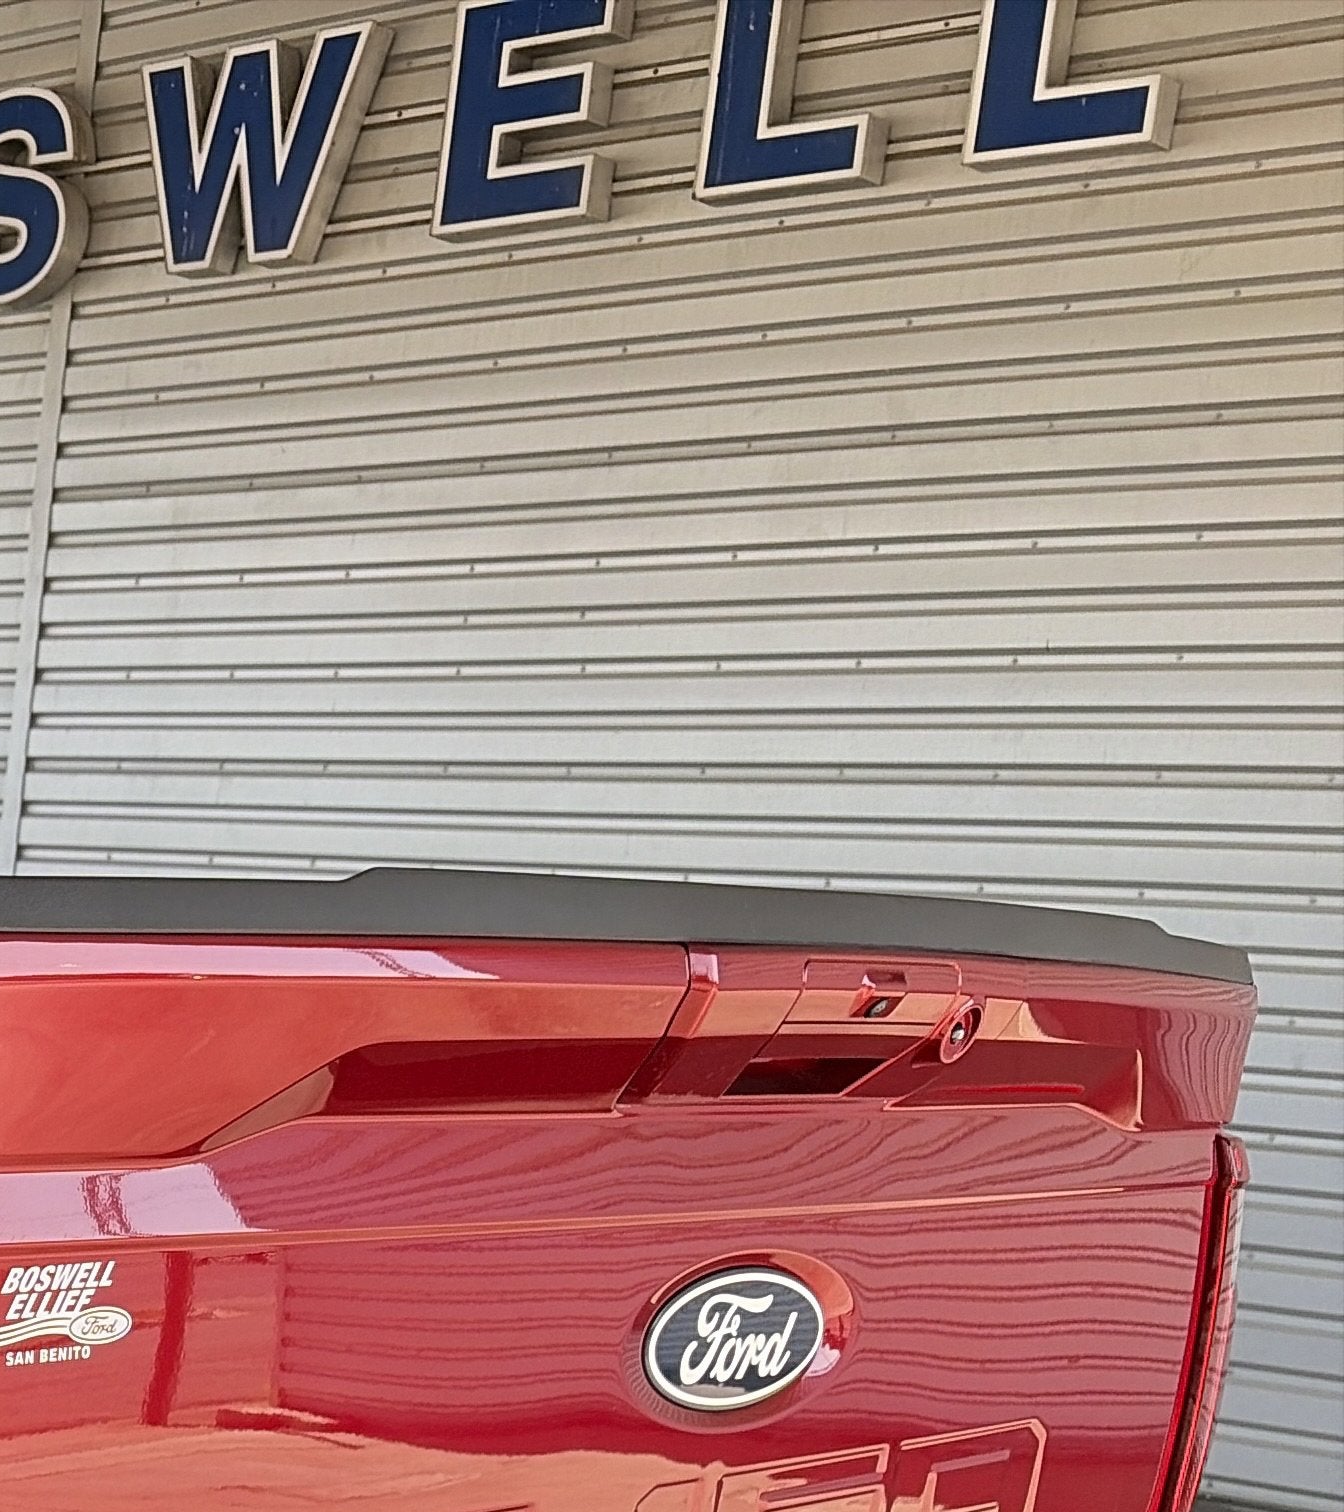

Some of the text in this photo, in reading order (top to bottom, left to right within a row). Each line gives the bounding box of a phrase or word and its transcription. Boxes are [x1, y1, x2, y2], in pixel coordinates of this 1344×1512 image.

[0, 1260, 116, 1295] BOSWELL
[81, 1315, 117, 1336] Ford
[680, 1292, 797, 1387] Ford
[4, 1345, 91, 1367] SAN BENITO
